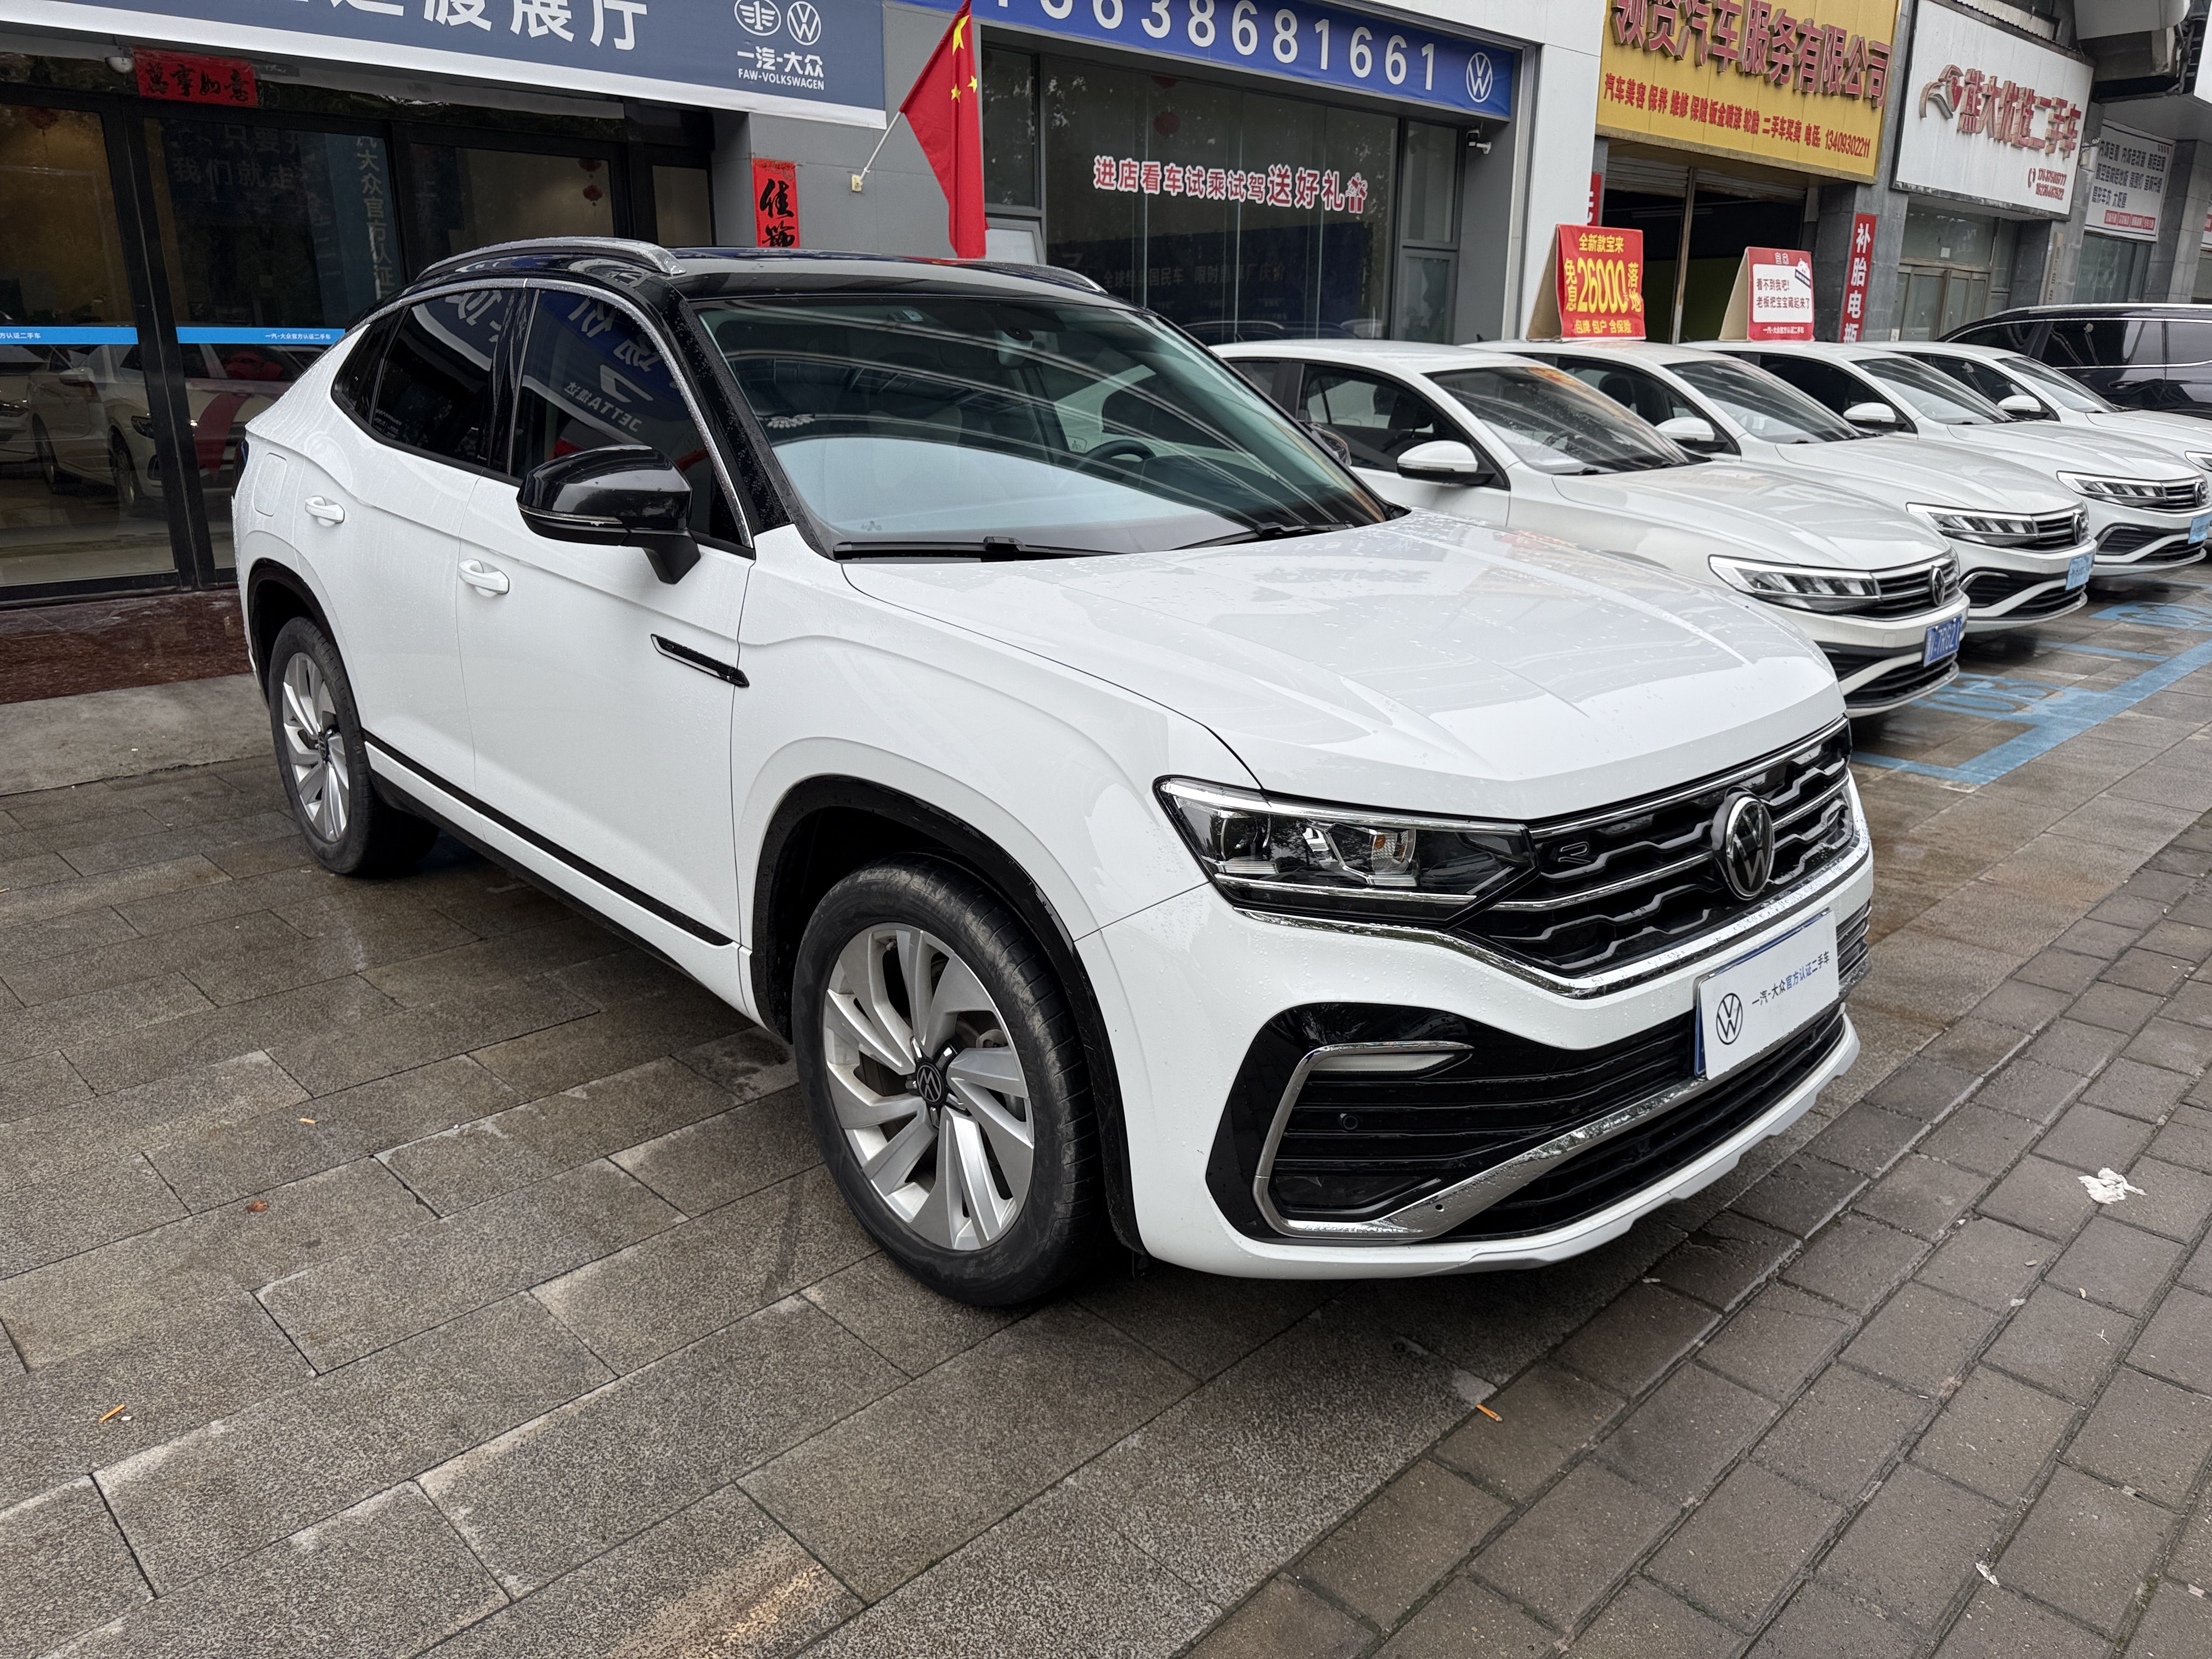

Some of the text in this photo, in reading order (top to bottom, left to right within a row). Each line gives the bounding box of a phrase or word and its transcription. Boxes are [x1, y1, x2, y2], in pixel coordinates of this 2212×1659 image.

[737, 46, 824, 77] 一汽-大众
[738, 68, 825, 90] FAW-VOLKSWAGEN
[1604, 73, 1646, 110] 汽车美容
[1648, 84, 1668, 114] 保养
[1670, 89, 1689, 119] 维修
[1743, 108, 1760, 135] 轮胎
[1762, 115, 1802, 143] 二手车买卖
[1578, 233, 1624, 254] 全新款宝来
[1577, 257, 1628, 314] 26000
[1752, 951, 1830, 1006] 一汽-大众官方认证二手车
